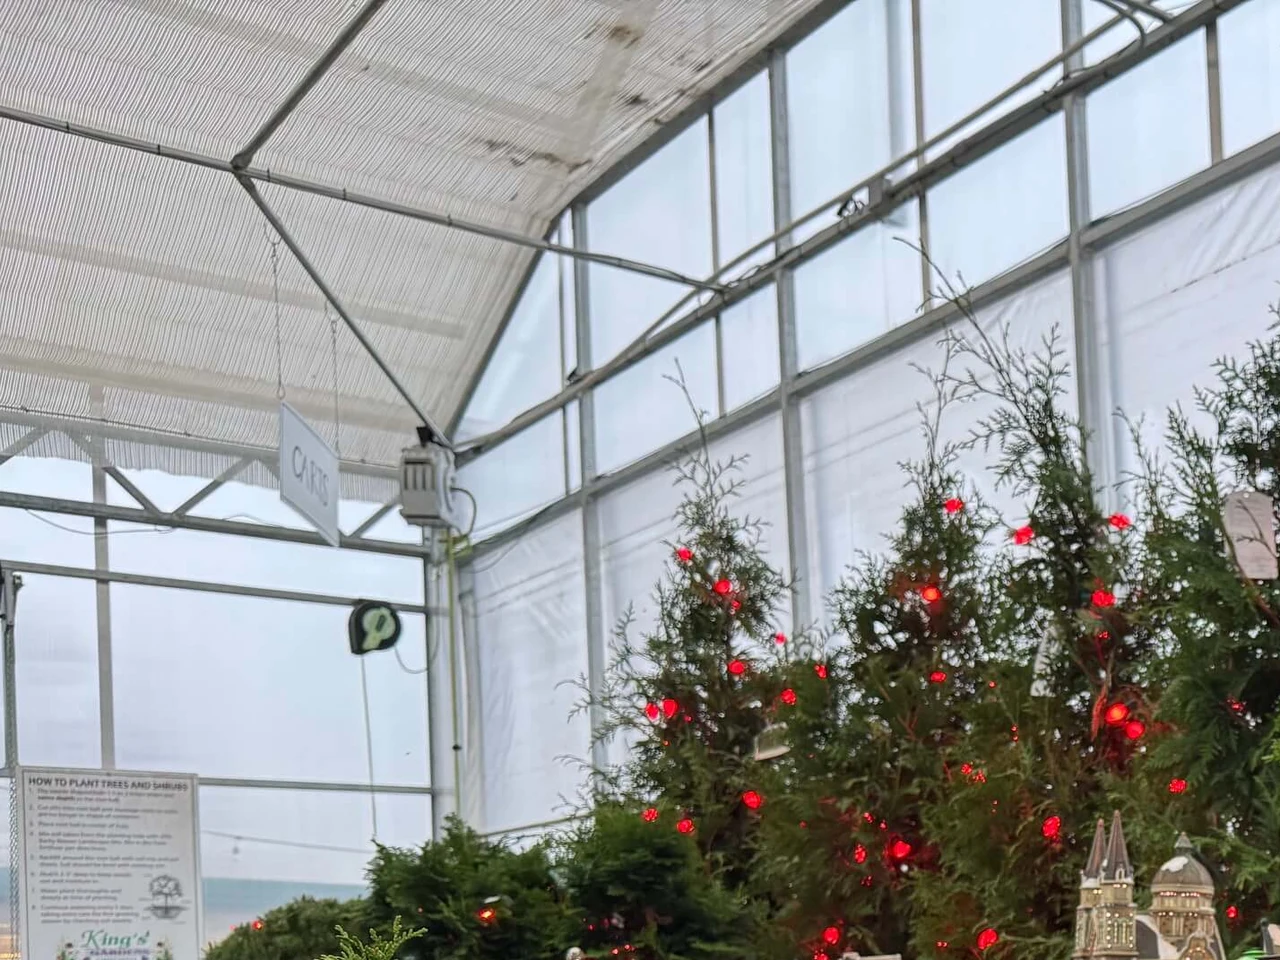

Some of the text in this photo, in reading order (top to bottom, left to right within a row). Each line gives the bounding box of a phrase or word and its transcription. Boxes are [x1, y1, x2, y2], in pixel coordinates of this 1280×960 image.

[291, 444, 330, 507] CARTS
[28, 777, 188, 792] HOW TO PLANT TREES AND SHRUBS
